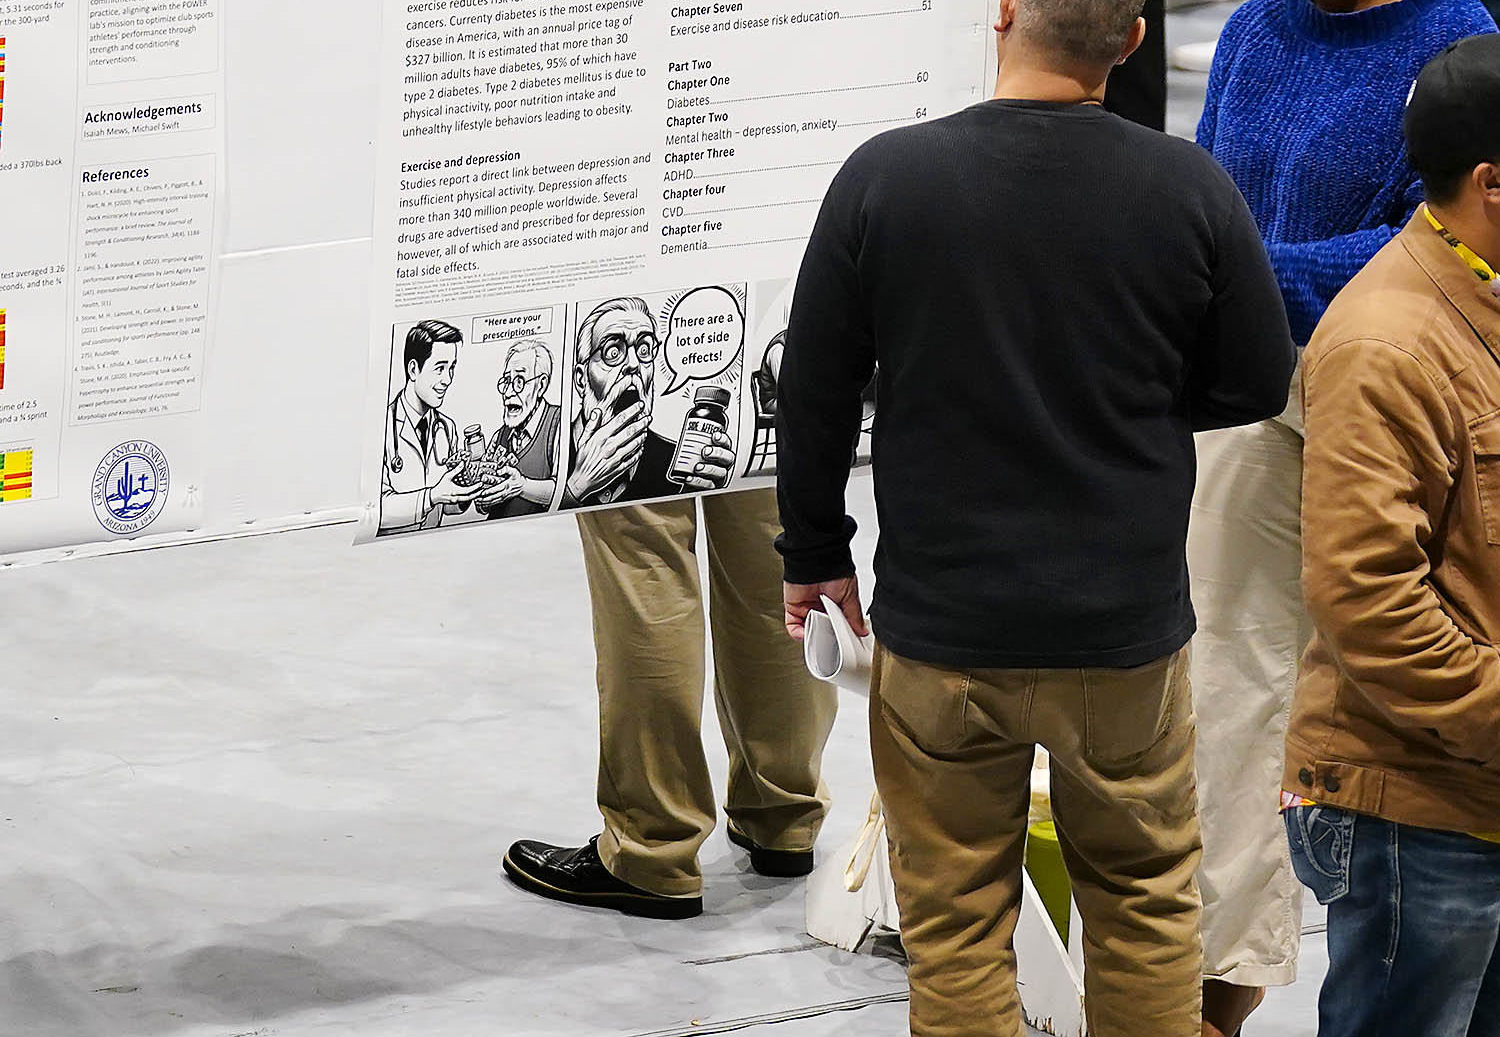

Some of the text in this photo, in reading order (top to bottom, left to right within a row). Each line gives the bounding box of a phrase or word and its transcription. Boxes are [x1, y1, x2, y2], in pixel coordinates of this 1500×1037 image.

[84, 102, 202, 124] Acknowledgements
[83, 128, 104, 139] Isaiah
[132, 122, 160, 133] Michael
[161, 120, 180, 131] Swift
[82, 167, 149, 183] References
[485, 318, 506, 326] "Here
[524, 314, 541, 324] your
[674, 317, 704, 328] There
[708, 316, 724, 325] are
[483, 326, 541, 342] prescriptions."
[676, 332, 729, 347] lot of side
[682, 352, 722, 365] effects!
[94, 443, 167, 506] GRAND CANYON UNIVERSITY
[103, 510, 155, 531] ARIZONA 1949
